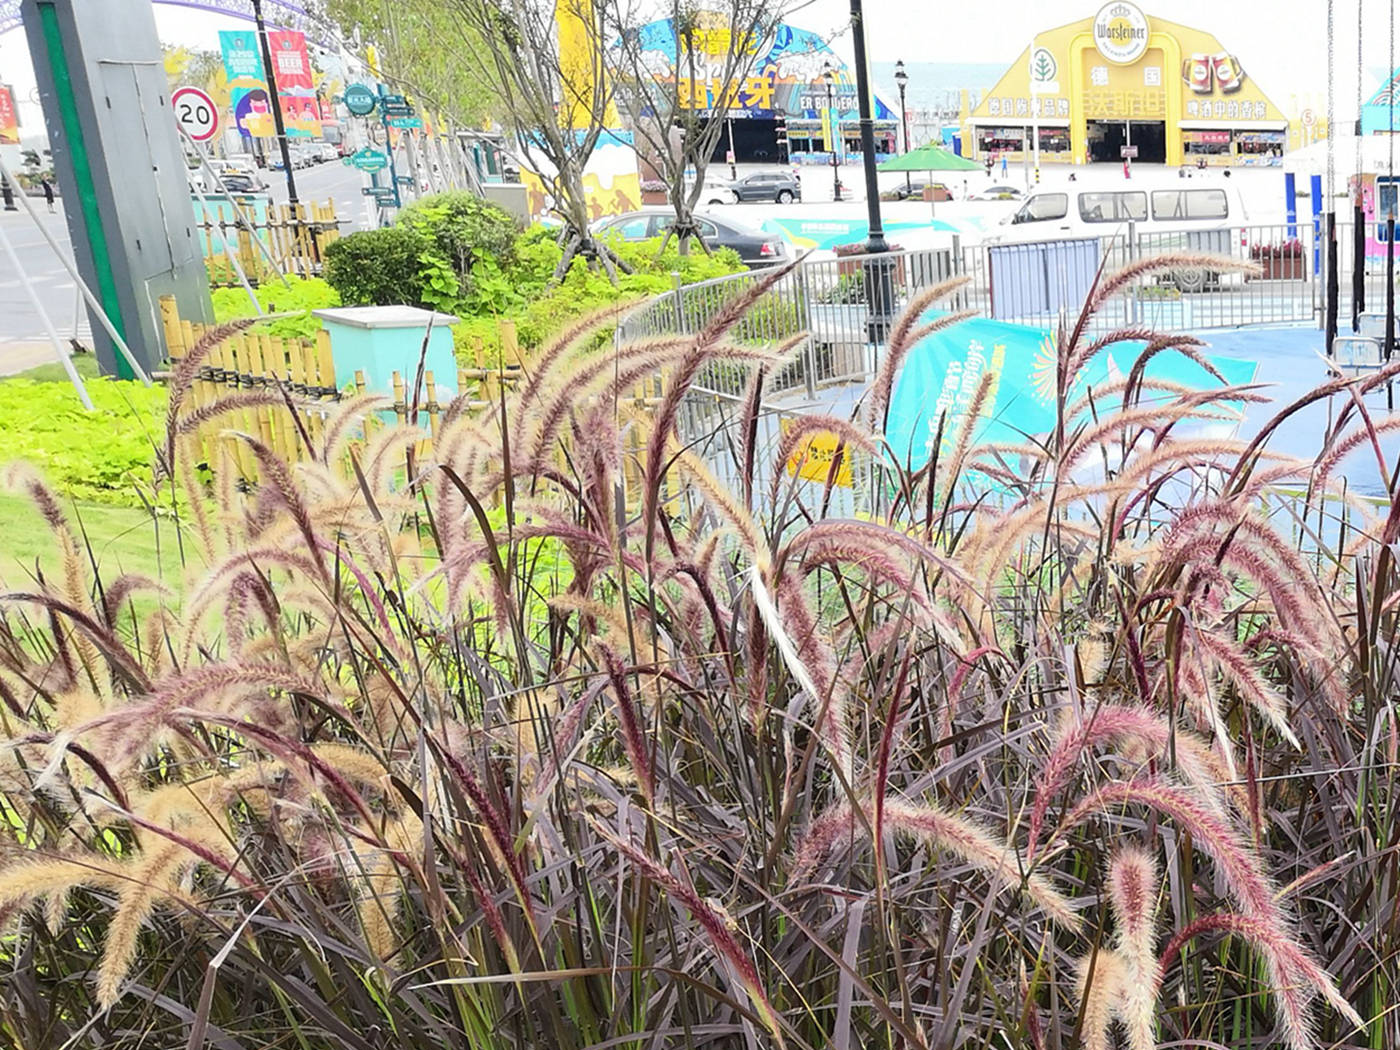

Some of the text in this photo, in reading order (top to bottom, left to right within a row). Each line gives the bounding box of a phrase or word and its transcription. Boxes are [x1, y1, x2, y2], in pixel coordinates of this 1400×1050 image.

[1097, 22, 1145, 40] Warsteiner
[815, 97, 860, 109] BOUERO
[179, 104, 210, 125] 20
